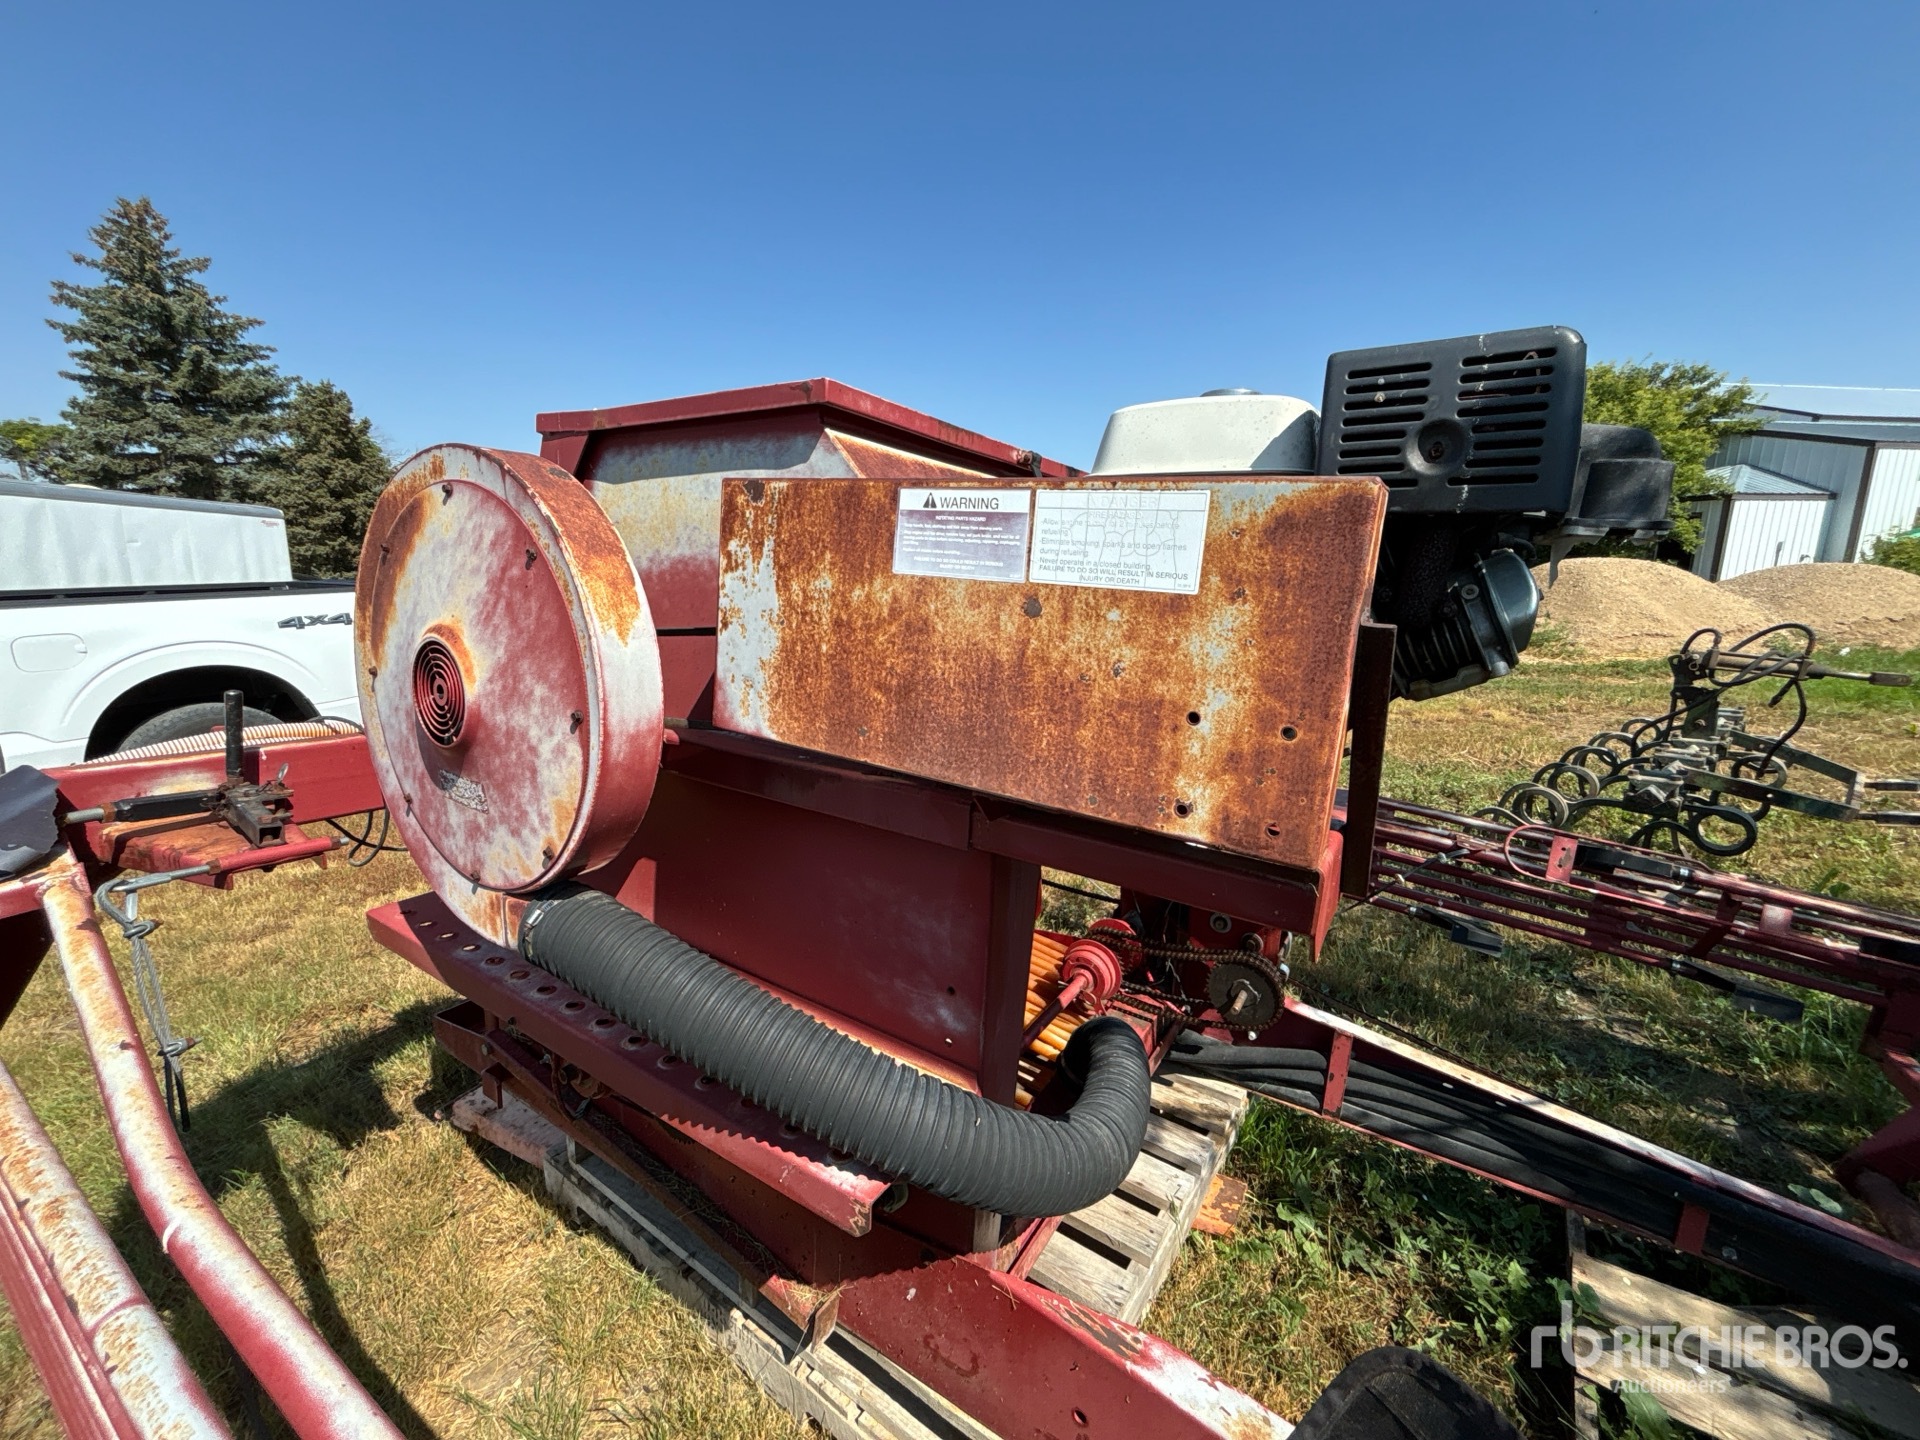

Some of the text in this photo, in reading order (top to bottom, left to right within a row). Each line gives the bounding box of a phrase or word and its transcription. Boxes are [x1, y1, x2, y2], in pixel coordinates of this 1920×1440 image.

[940, 497, 999, 510] WARNING
[1127, 541, 1141, 549] and
[1059, 559, 1084, 567] operate
[1099, 560, 1122, 568] closed
[1039, 564, 1066, 572] FAILURE
[1117, 569, 1144, 577] RESULT
[1155, 571, 1189, 580] SERIOUS
[1116, 577, 1140, 585] DEATH
